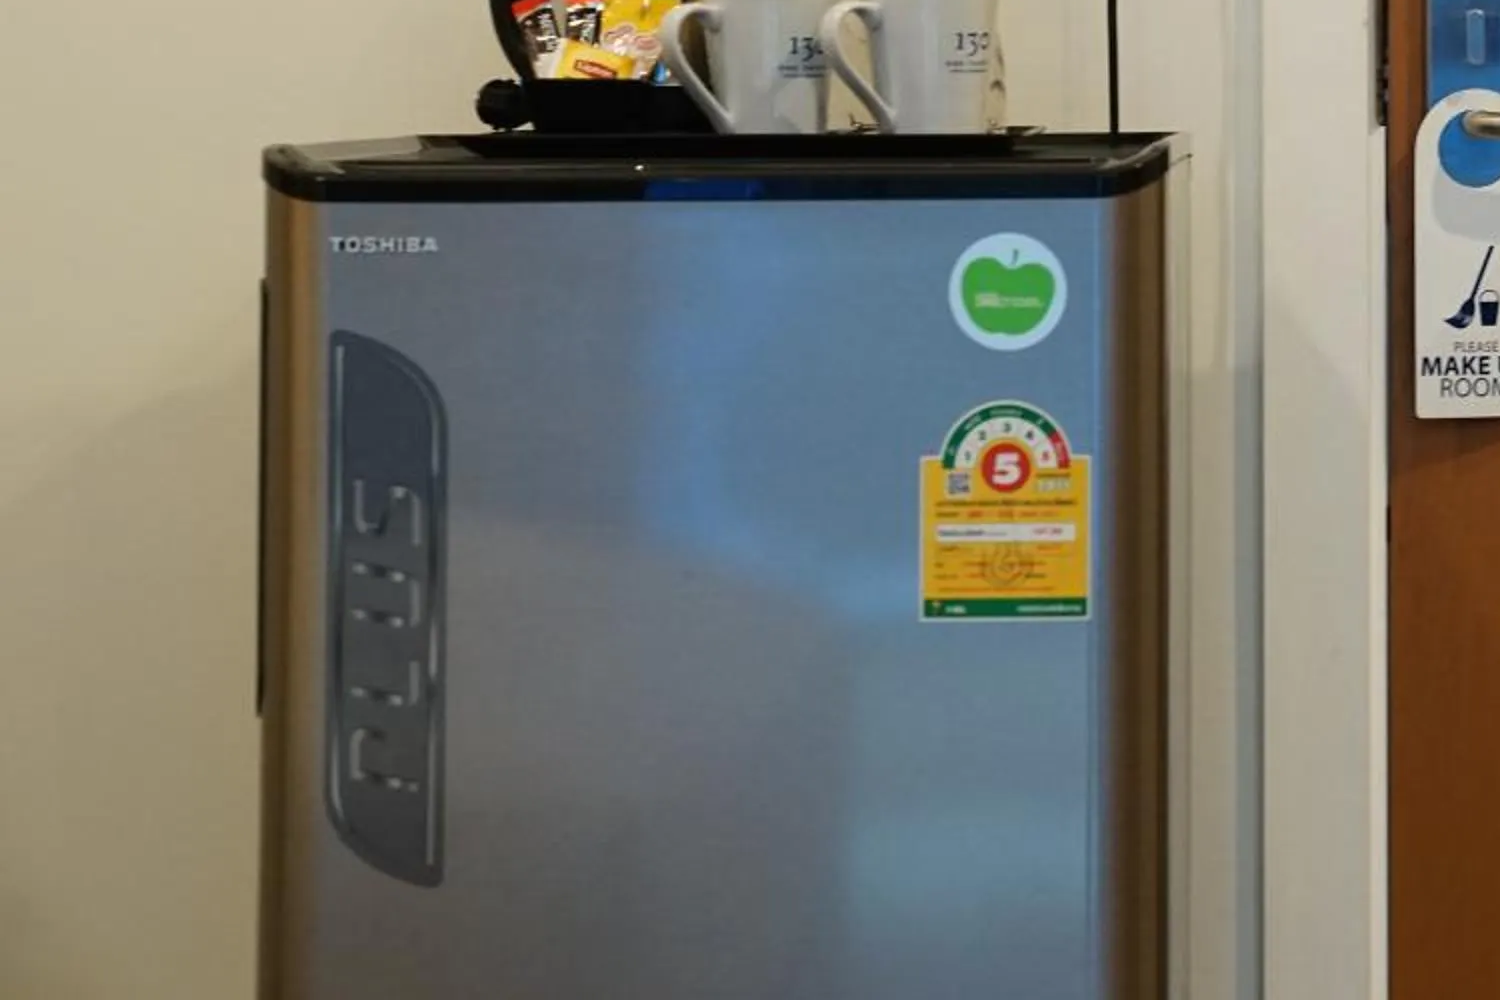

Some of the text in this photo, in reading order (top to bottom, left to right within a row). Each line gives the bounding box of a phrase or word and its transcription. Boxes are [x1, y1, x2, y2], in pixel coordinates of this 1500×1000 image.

[328, 236, 440, 253] TOSHIBA
[1453, 341, 1500, 352] PLEASE
[1421, 355, 1491, 377] MAKE
[991, 451, 1023, 486] 5
